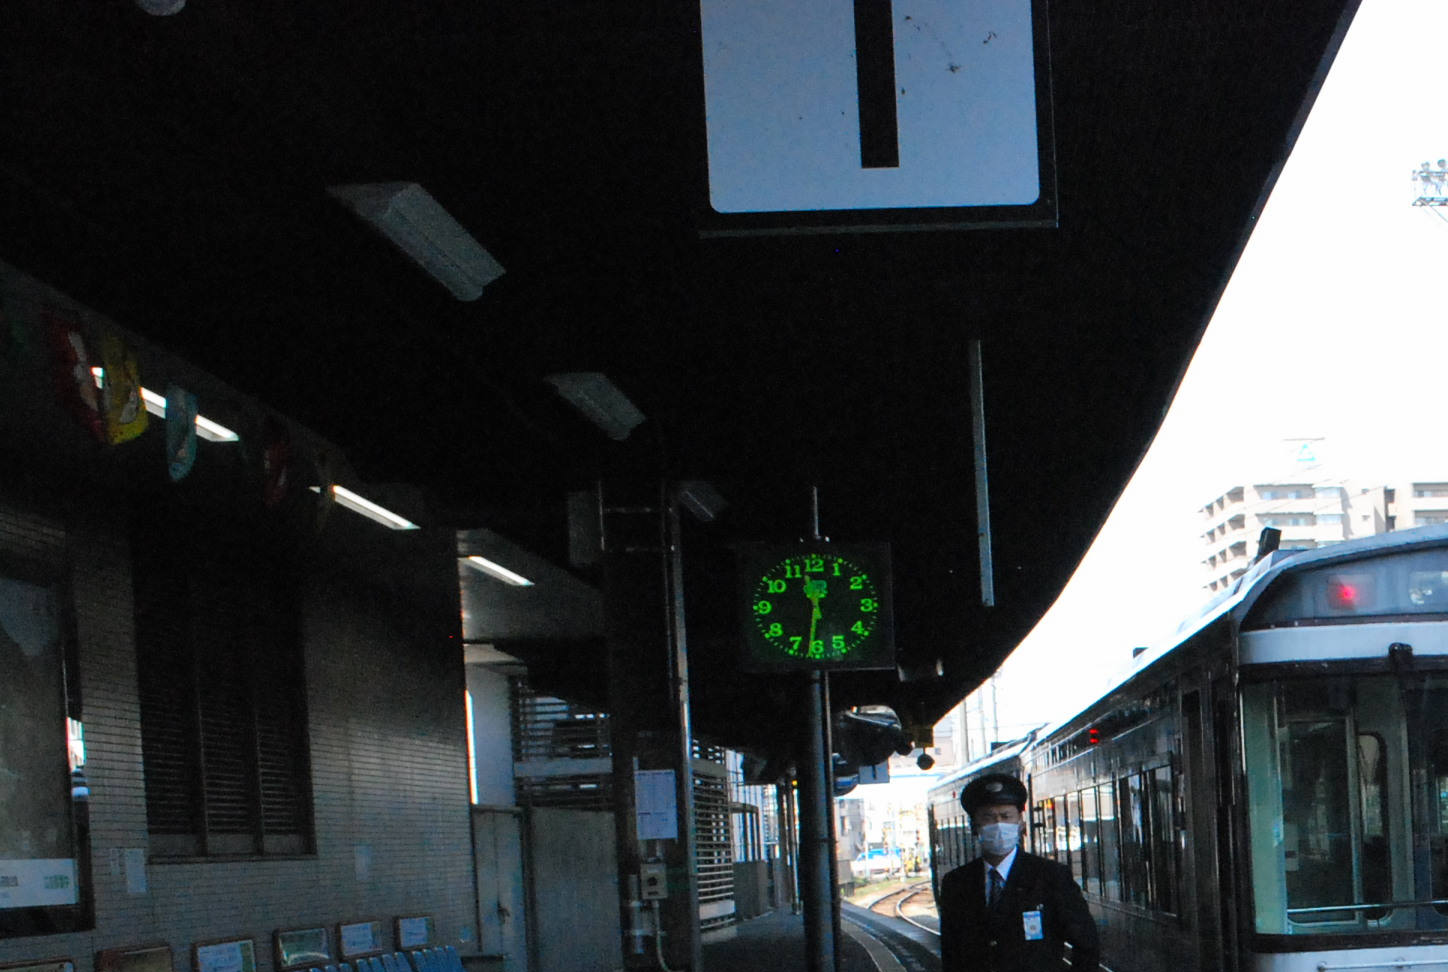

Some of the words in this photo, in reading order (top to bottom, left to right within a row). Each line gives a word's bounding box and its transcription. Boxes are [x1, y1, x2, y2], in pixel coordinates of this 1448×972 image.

[785, 564, 802, 578] 11
[804, 559, 824, 572] 12
[833, 563, 840, 576] 1
[767, 579, 787, 593] 10
[850, 576, 863, 589] 2
[758, 600, 772, 614] 9
[860, 599, 873, 612] 3
[769, 623, 783, 637] 8
[851, 620, 864, 634] 4
[789, 636, 802, 649] 7
[812, 640, 824, 654] 6
[832, 635, 845, 649] 5
